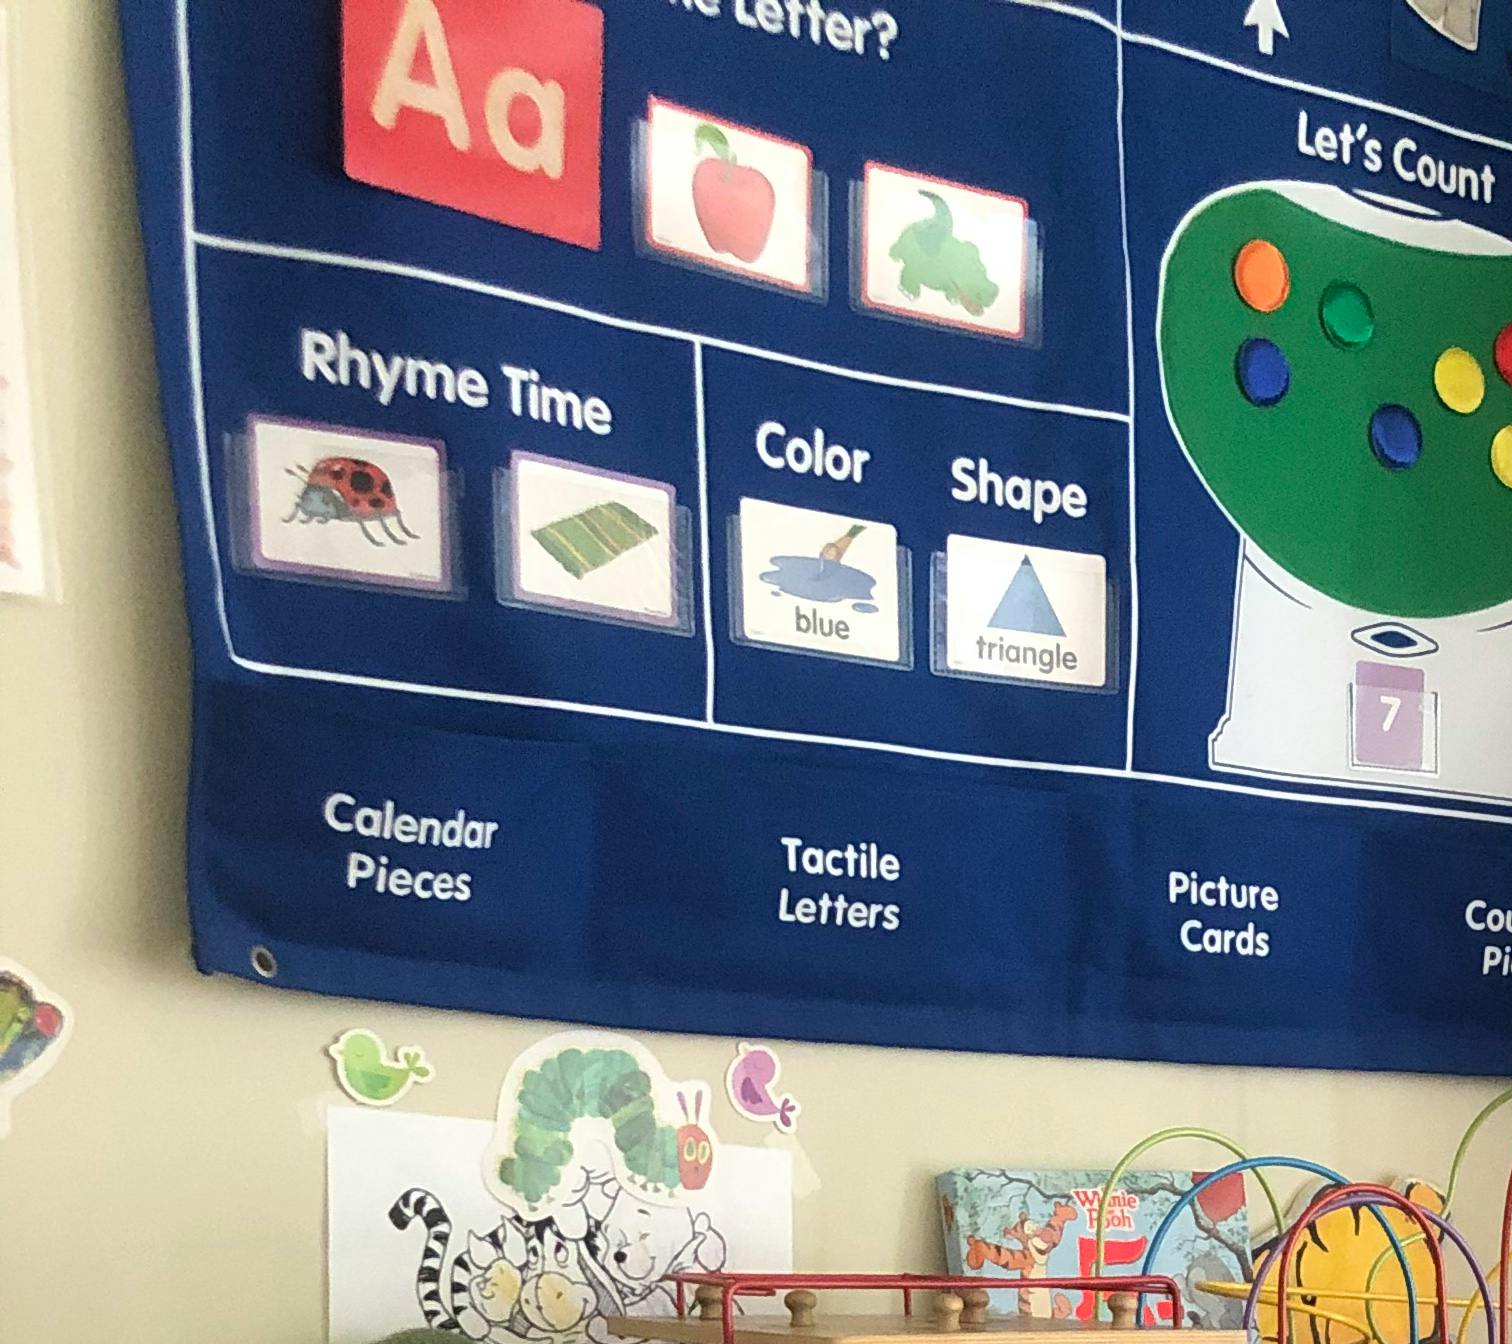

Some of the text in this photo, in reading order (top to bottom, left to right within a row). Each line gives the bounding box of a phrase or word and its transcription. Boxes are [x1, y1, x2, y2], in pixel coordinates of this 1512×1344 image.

[1298, 111, 1497, 206] Let's Count
[301, 328, 613, 436] Rhyme Time
[755, 420, 871, 483] Color
[951, 456, 1088, 524] Shape
[795, 606, 851, 640] blue
[975, 635, 1078, 674] triangle
[1379, 695, 1403, 733] 7
[323, 792, 499, 851] Calendar
[346, 852, 471, 902] Pieces
[780, 836, 902, 882] Tactile
[777, 887, 901, 931] Letters
[1168, 871, 1280, 912] Picture
[1180, 919, 1271, 958] Cards
